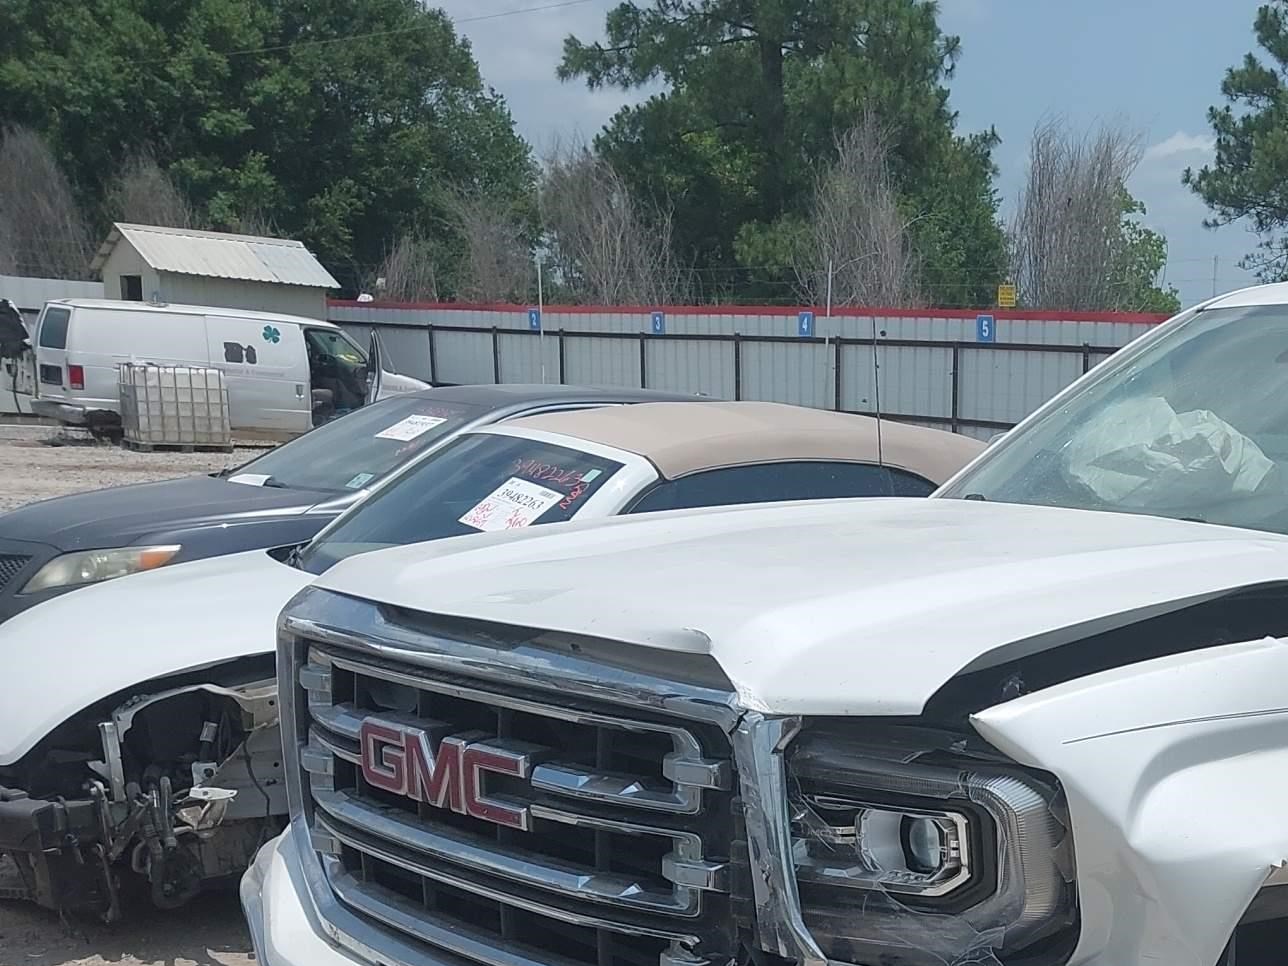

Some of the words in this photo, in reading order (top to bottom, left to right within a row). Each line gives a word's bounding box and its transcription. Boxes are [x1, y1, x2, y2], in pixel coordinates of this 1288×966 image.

[531, 312, 537, 326] 2
[655, 316, 661, 331] 3
[802, 316, 808, 332] 4
[982, 320, 989, 337] 5
[360, 716, 529, 831] GMC
